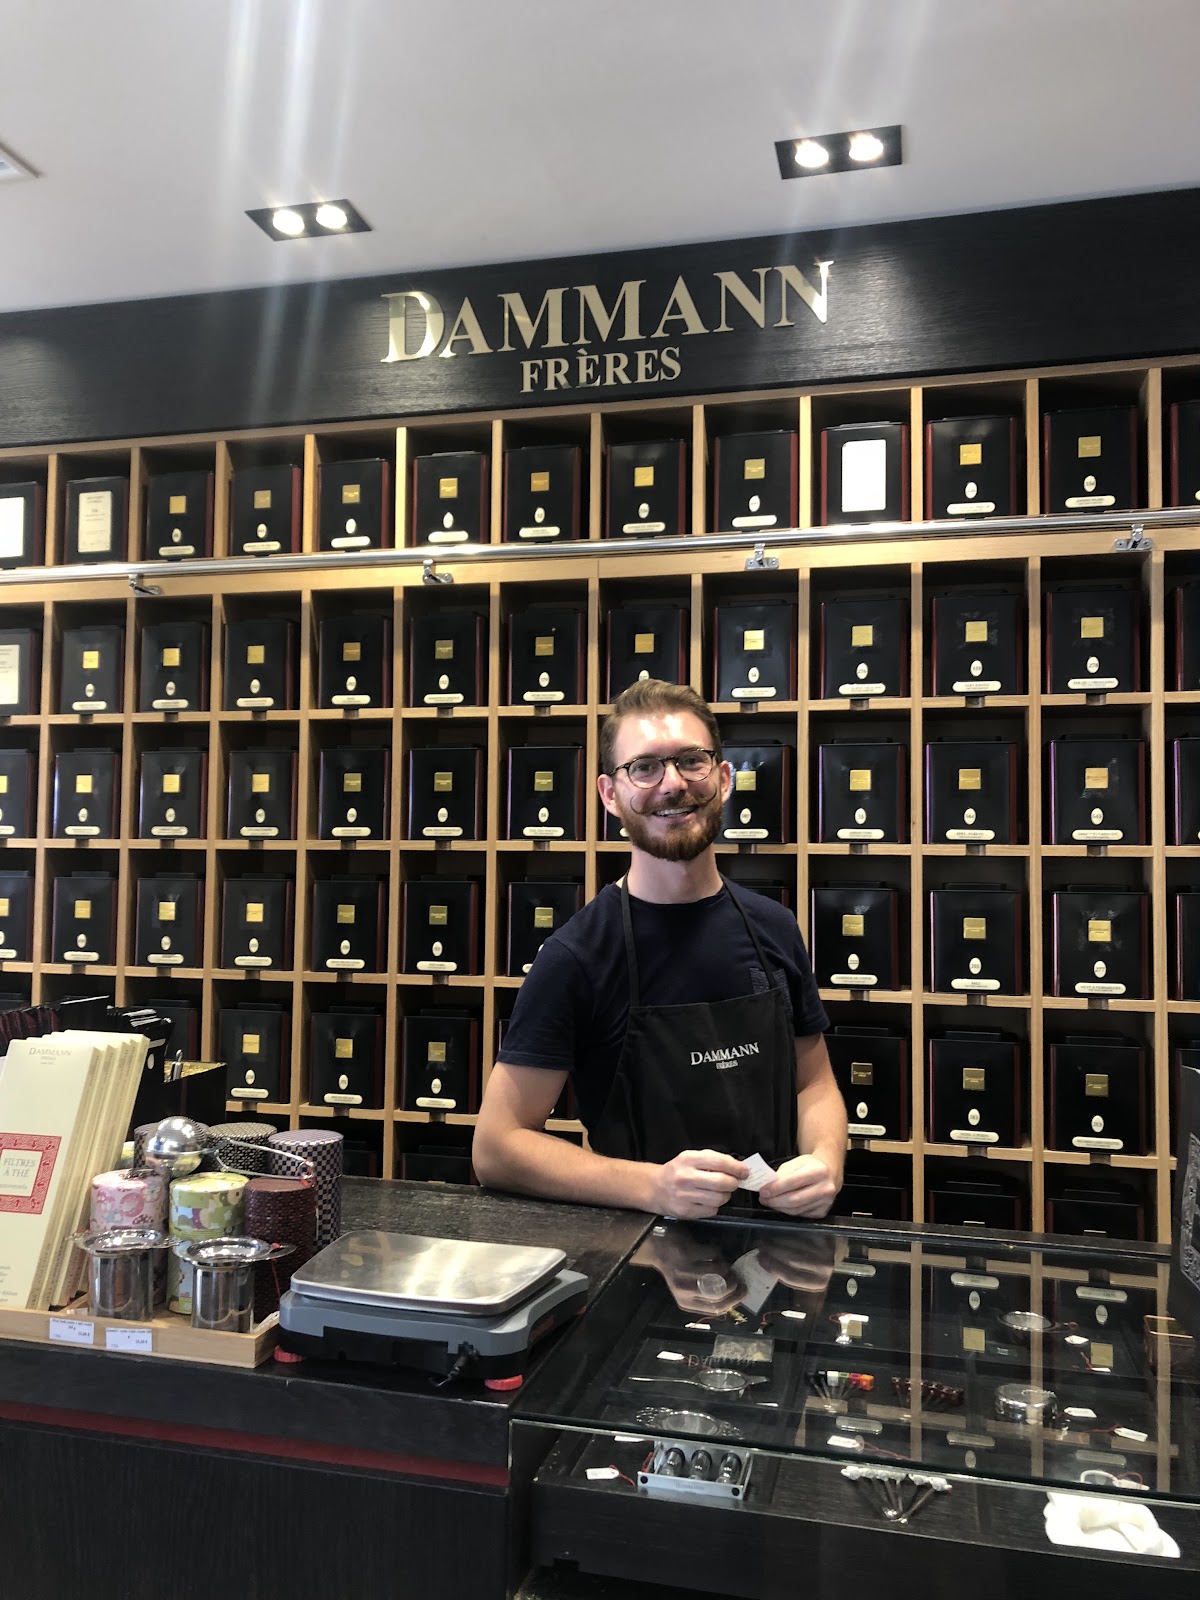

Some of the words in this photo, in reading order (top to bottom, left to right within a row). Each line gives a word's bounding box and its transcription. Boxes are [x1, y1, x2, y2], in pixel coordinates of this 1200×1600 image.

[380, 260, 835, 364] DAMMANN
[519, 346, 682, 394] FRÈRES
[690, 1042, 760, 1066] DAMMANN
[3, 1157, 37, 1168] FILTRES
